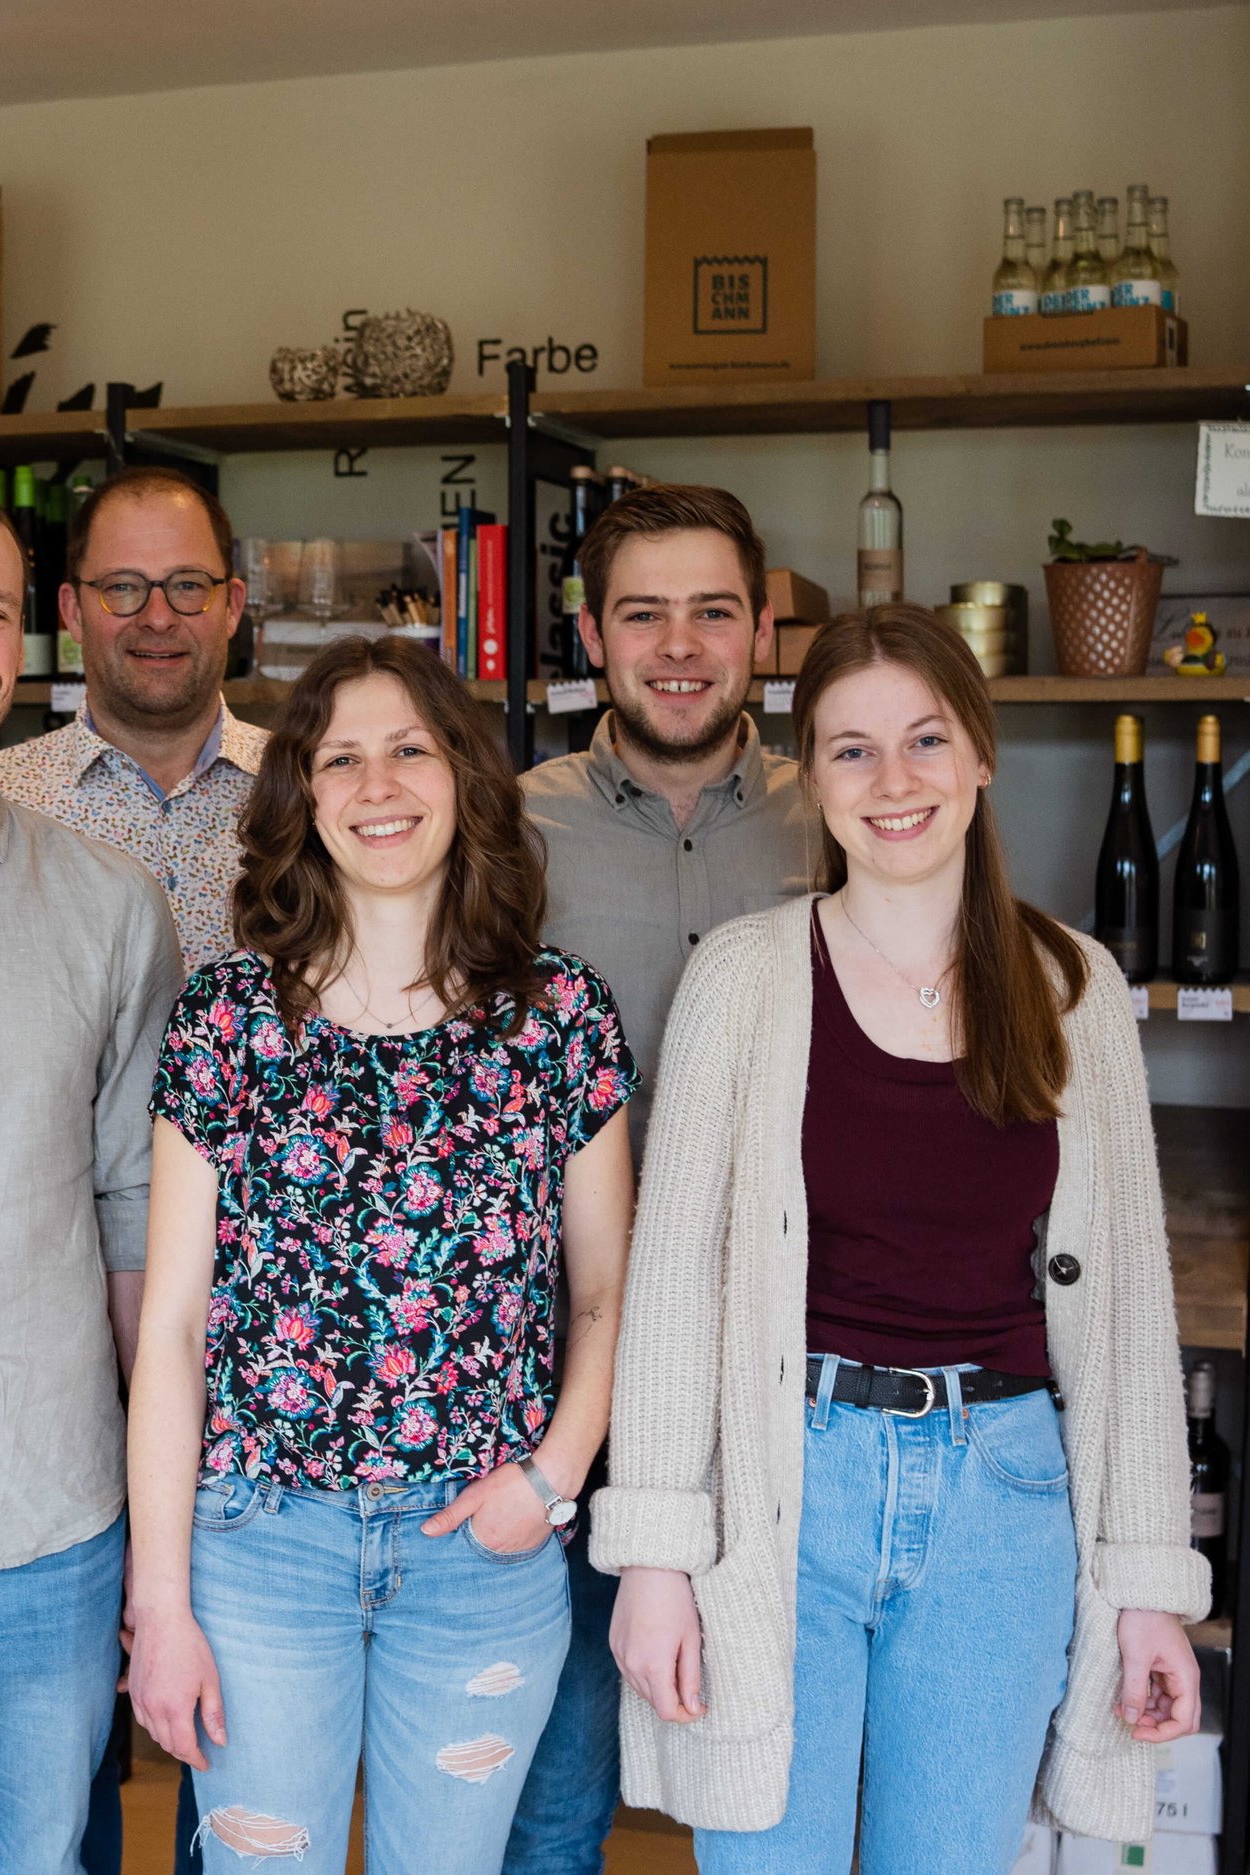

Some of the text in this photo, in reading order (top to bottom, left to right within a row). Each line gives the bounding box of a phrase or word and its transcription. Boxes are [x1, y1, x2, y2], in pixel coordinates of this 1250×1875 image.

[711, 274, 749, 290] BIS
[711, 306, 749, 320] ANN
[477, 336, 598, 377] Farbe
[539, 512, 573, 680] lassic
[1156, 1802, 1177, 1817] 75
